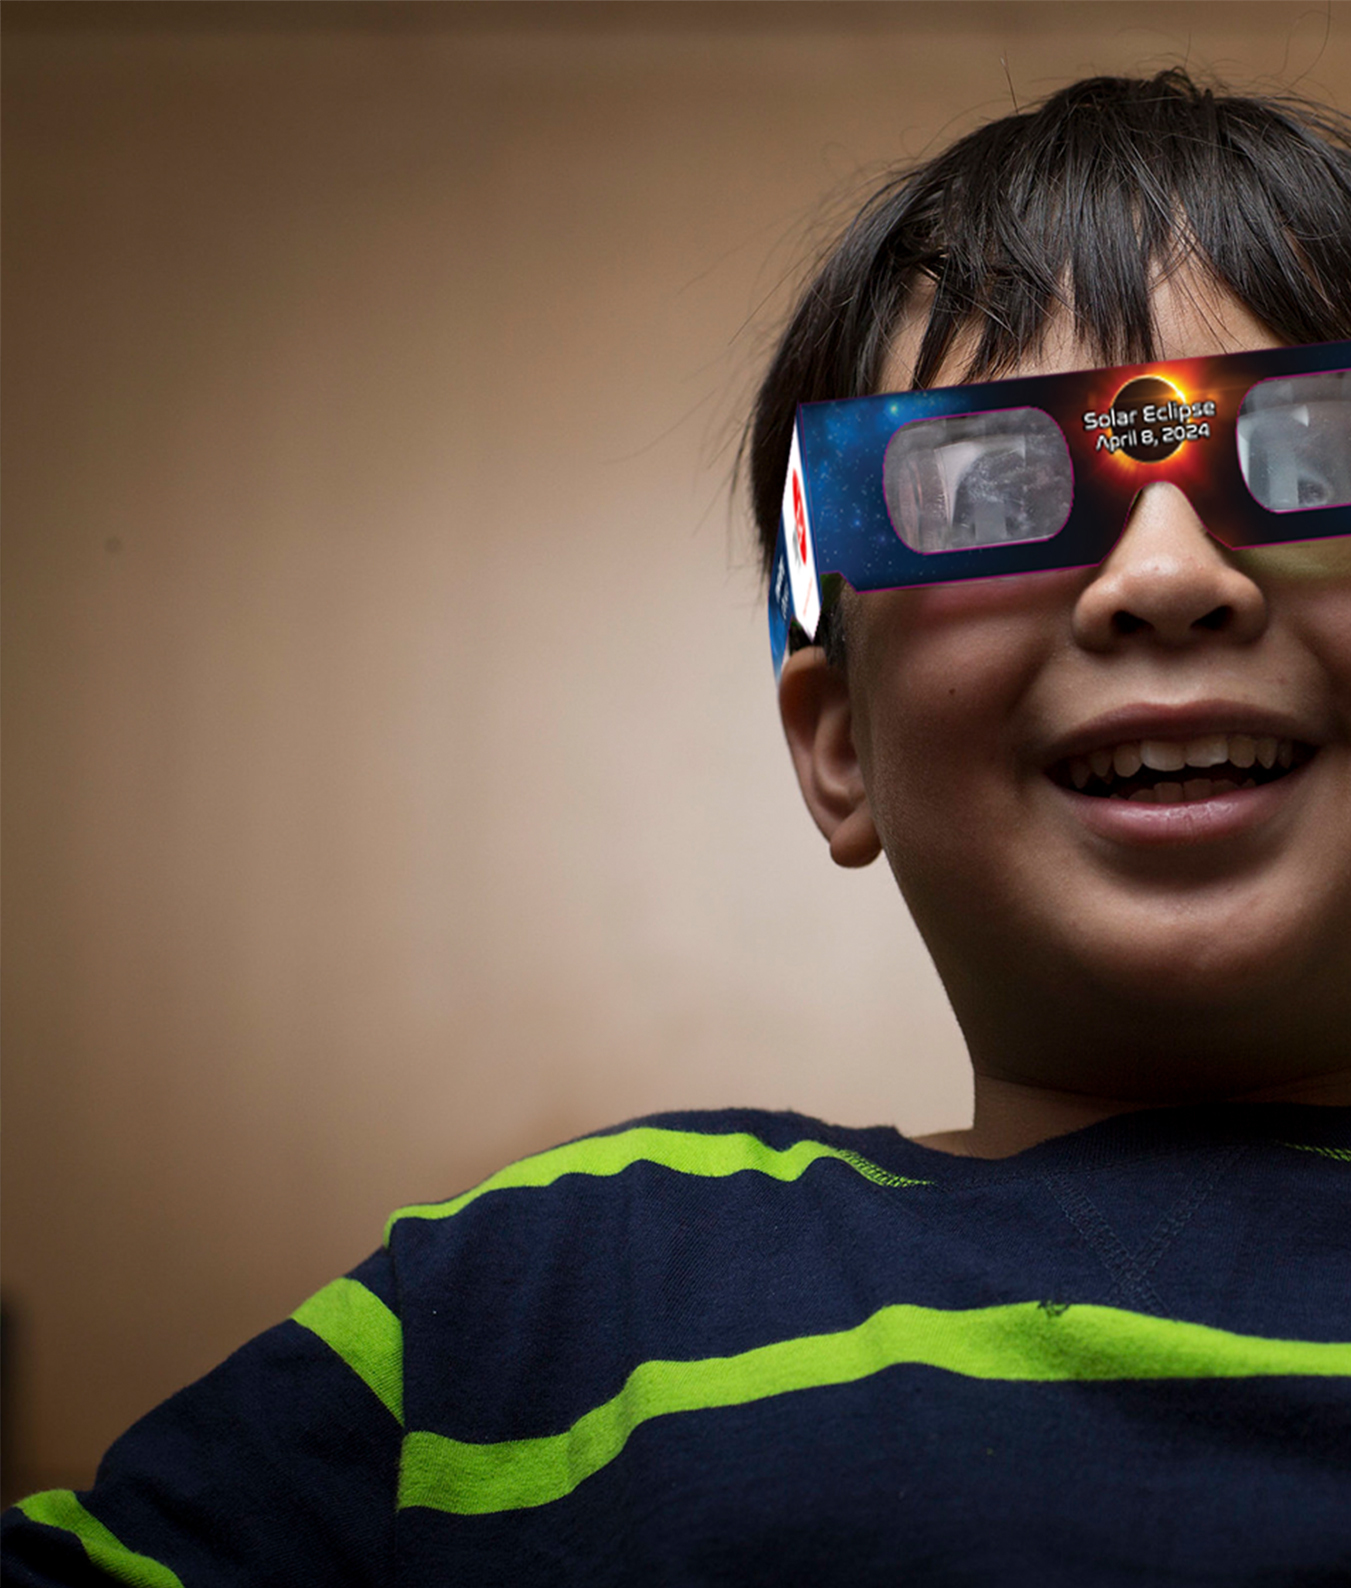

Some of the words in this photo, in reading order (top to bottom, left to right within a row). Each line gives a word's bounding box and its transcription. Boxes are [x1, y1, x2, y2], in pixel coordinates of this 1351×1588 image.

[1083, 407, 1138, 430] Solar
[1142, 401, 1216, 423] Eclipse
[1096, 429, 1138, 453] April
[1141, 429, 1159, 447] 8,
[1162, 422, 1210, 443] 2024
